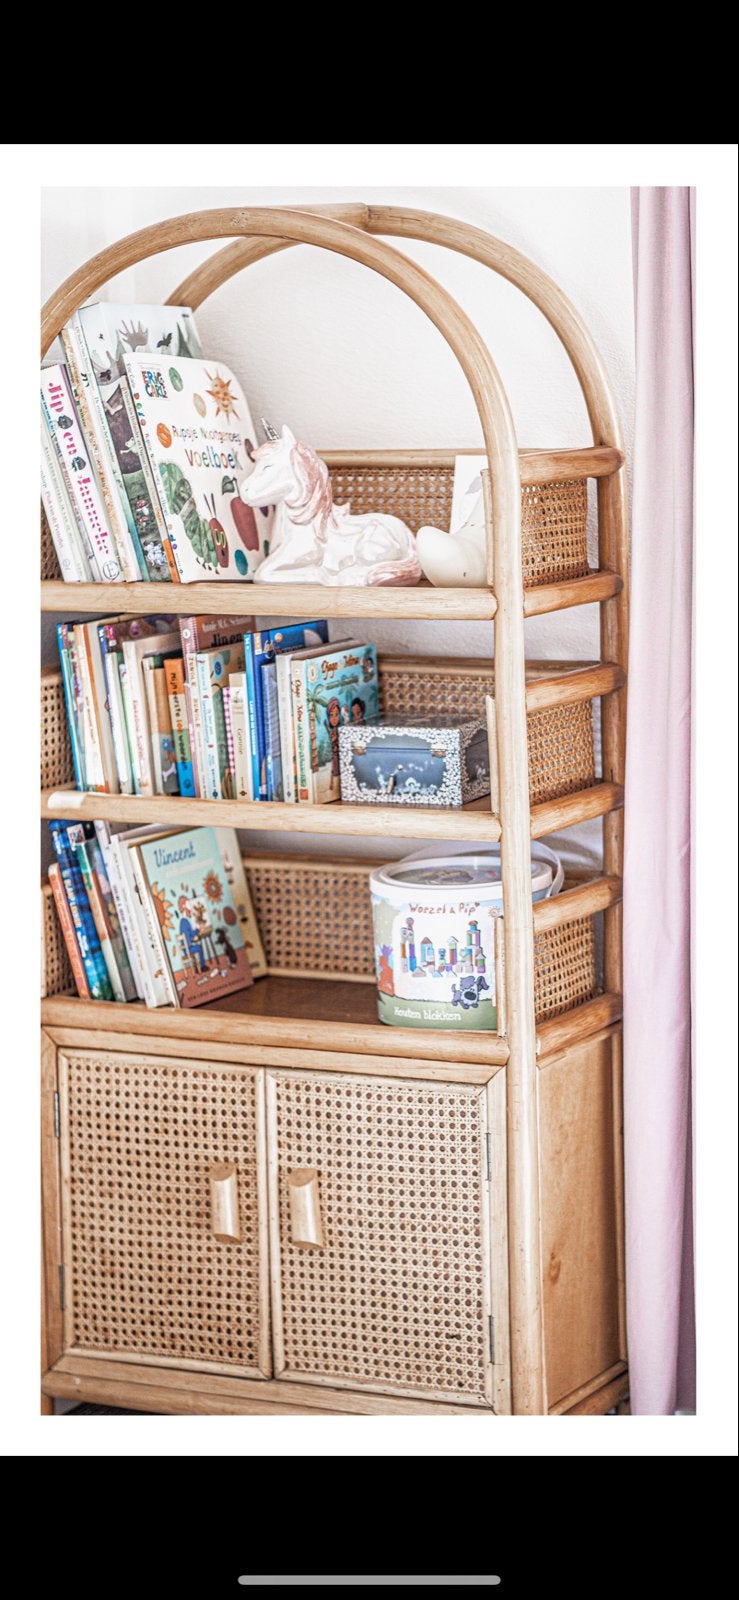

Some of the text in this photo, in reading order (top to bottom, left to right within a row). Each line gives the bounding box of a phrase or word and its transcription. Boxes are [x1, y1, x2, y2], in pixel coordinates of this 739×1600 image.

[141, 370, 166, 386] ERIC
[145, 384, 168, 399] CARLE
[48, 381, 65, 414] Jip
[63, 431, 78, 456] en
[77, 474, 110, 556] Janneke
[168, 672, 188, 771] Mijn eerste 100 woorden
[235, 727, 246, 755] Gonnie
[153, 840, 197, 868] Vincent
[408, 902, 447, 915] Woezel
[458, 901, 477, 916] Pip
[393, 1006, 461, 1022] Houten blokken
